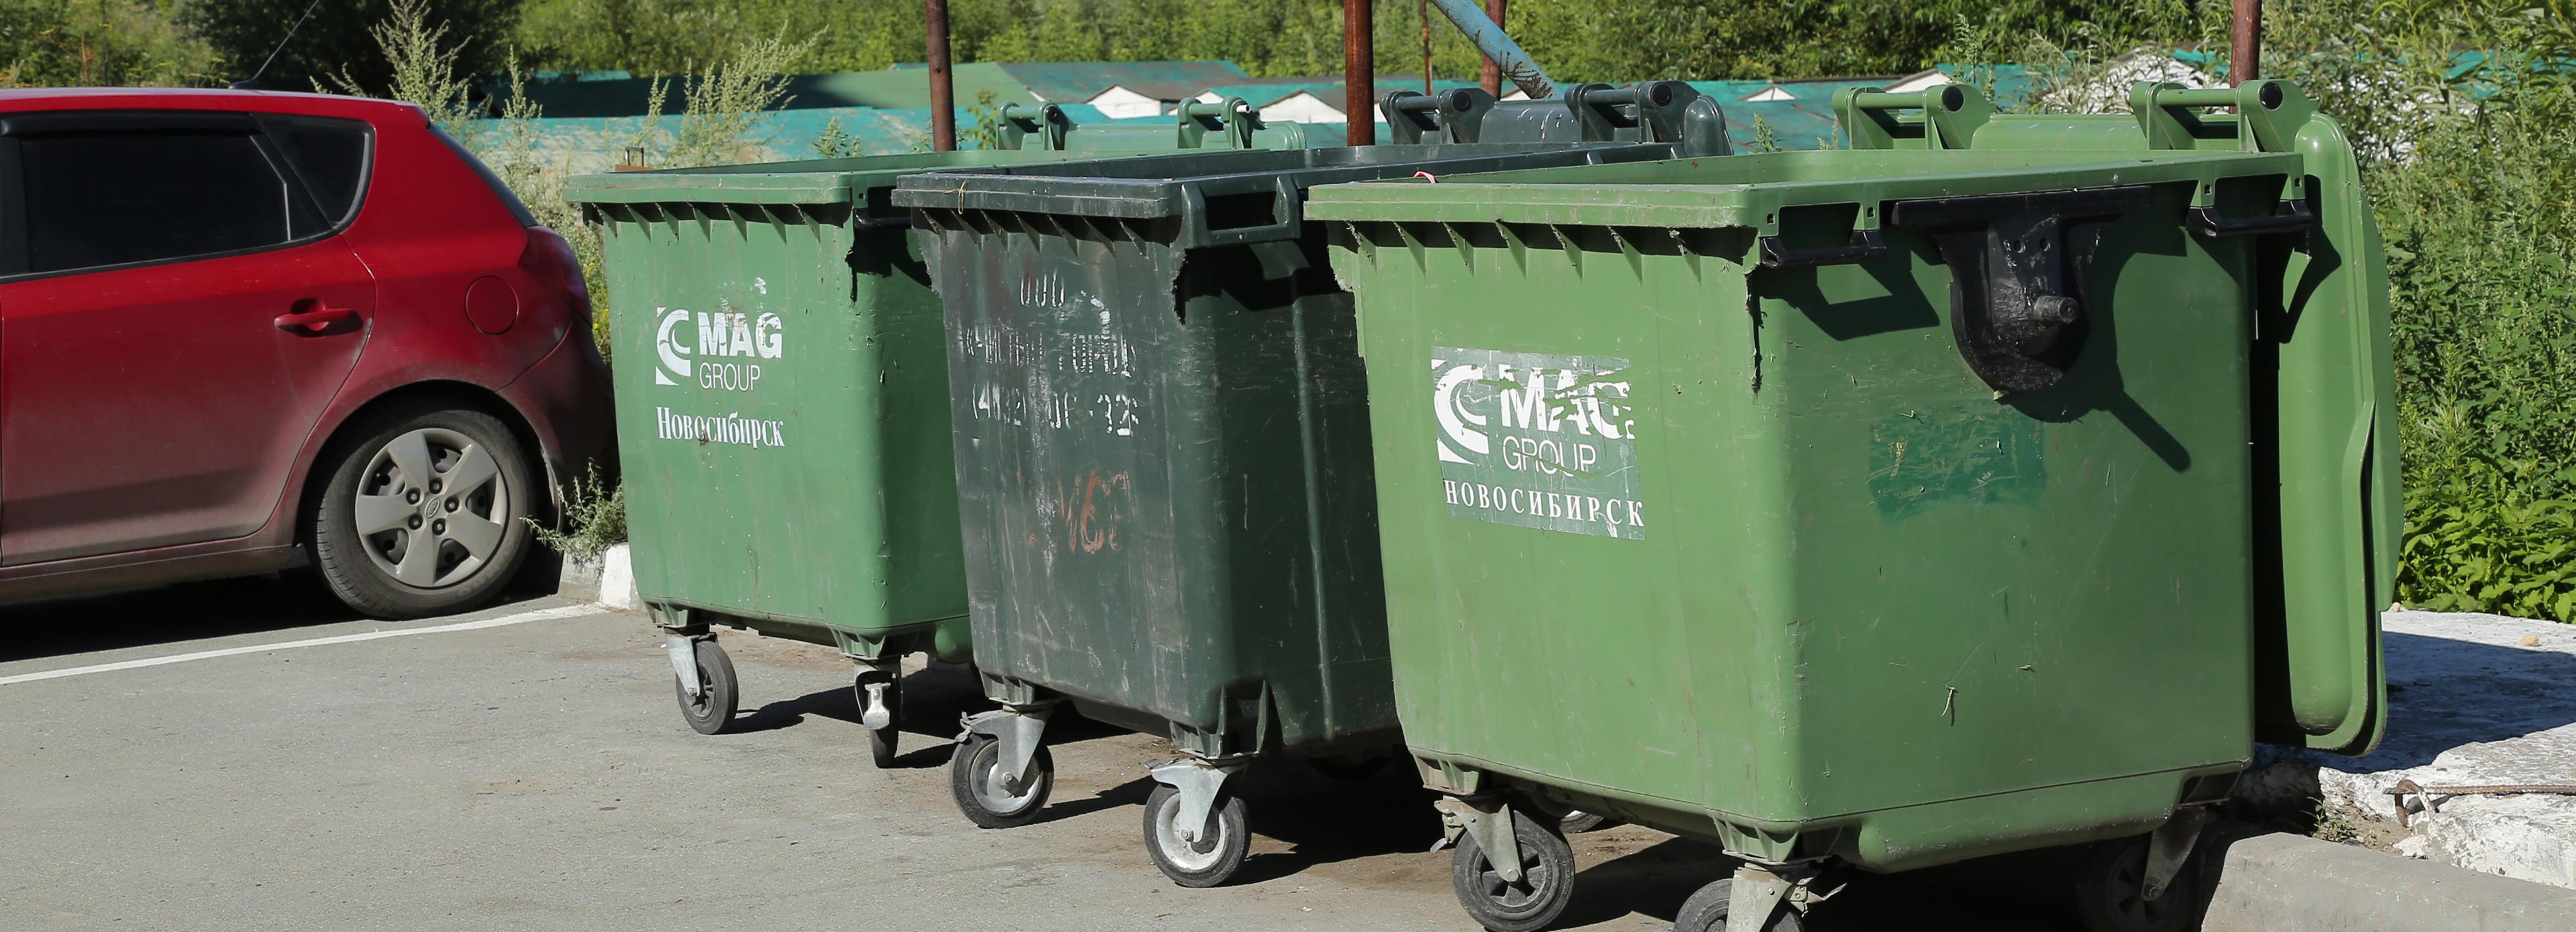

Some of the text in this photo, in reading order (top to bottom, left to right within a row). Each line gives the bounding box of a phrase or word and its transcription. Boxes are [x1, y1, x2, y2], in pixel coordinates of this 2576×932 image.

[697, 312, 782, 359] MAG
[699, 362, 761, 392] GROUP
[1499, 364, 1635, 440] MAG
[656, 406, 785, 449] Новосибирск
[1503, 436, 1596, 477] GROUP
[1444, 479, 1644, 526] НОВОСИБИРСК
